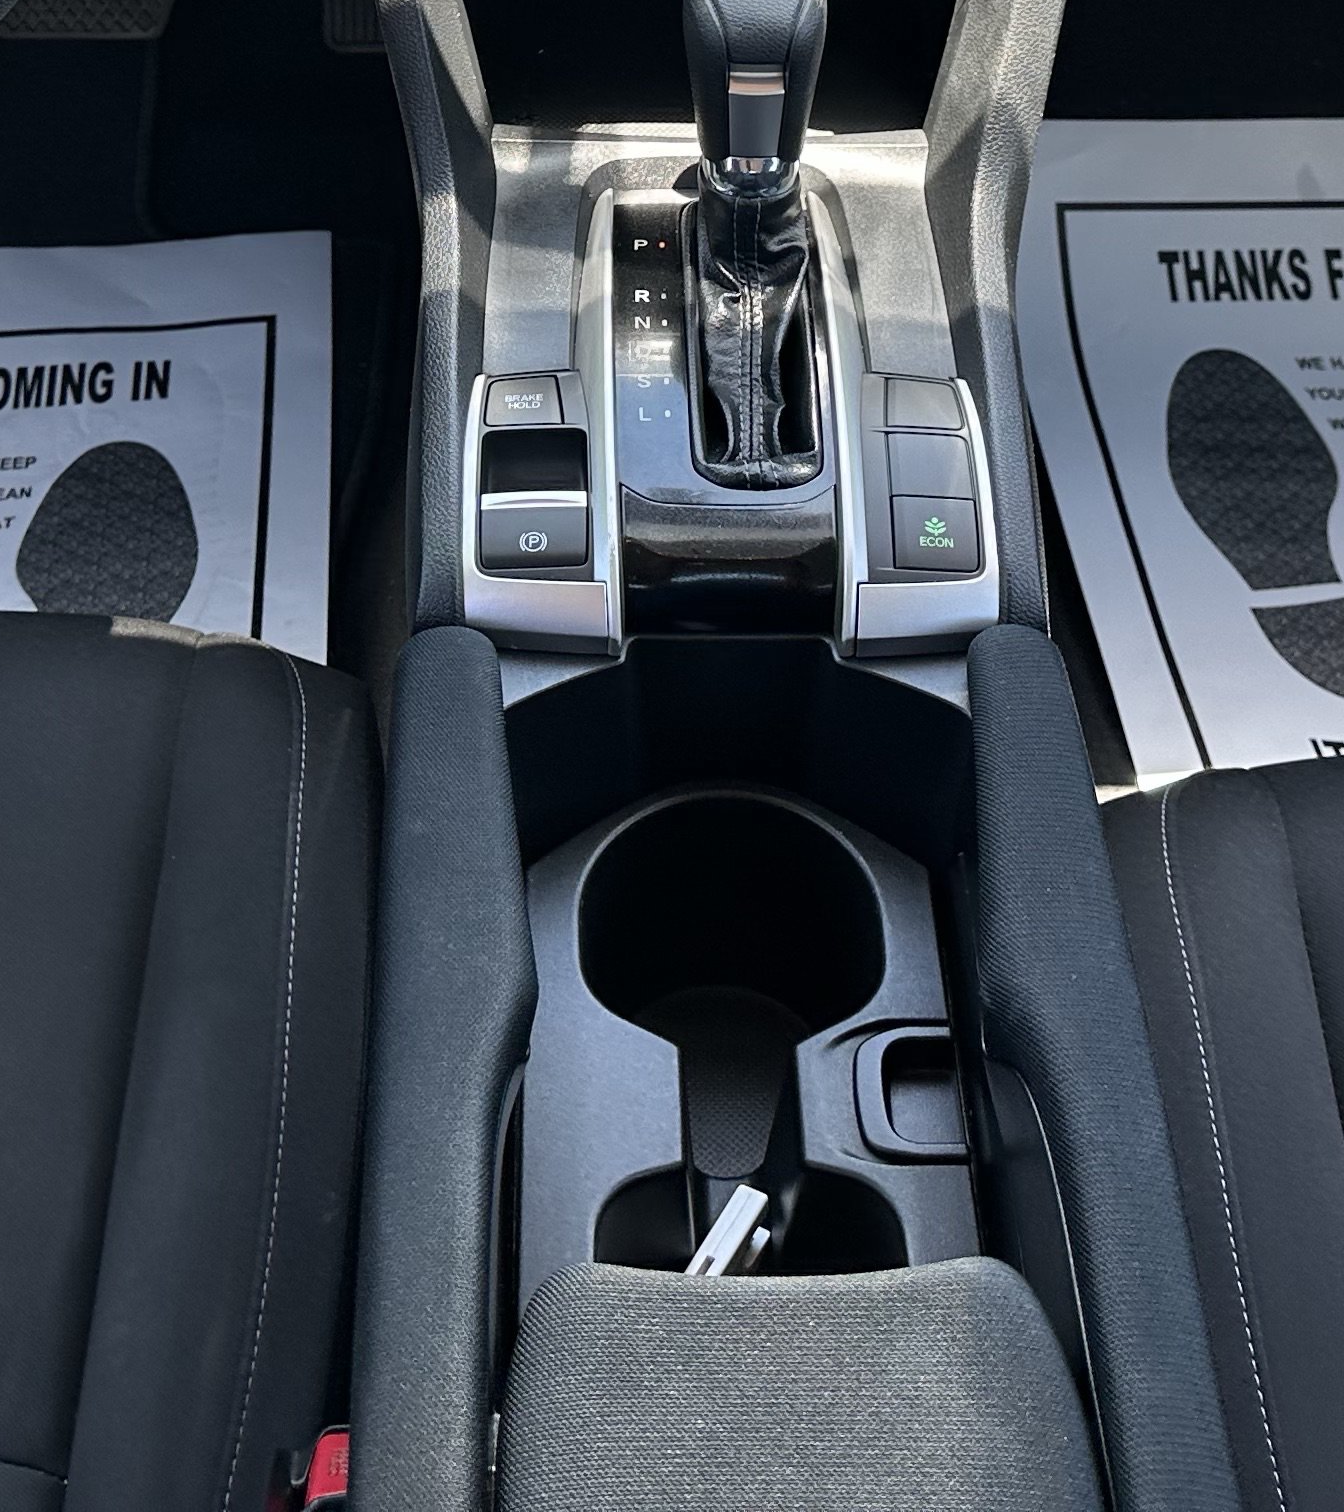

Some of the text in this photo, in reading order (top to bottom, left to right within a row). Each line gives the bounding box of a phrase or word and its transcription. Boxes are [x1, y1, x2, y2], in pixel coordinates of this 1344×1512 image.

[634, 239, 649, 251] P
[1158, 248, 1312, 303] THANKS
[634, 290, 650, 303] R
[634, 317, 651, 329] N
[1294, 355, 1326, 371] WE
[130, 359, 172, 401] IN
[637, 375, 651, 388] S
[505, 394, 544, 403] BRAKE
[508, 401, 541, 409] HOLD
[639, 407, 652, 421] L
[919, 536, 954, 548] ECON
